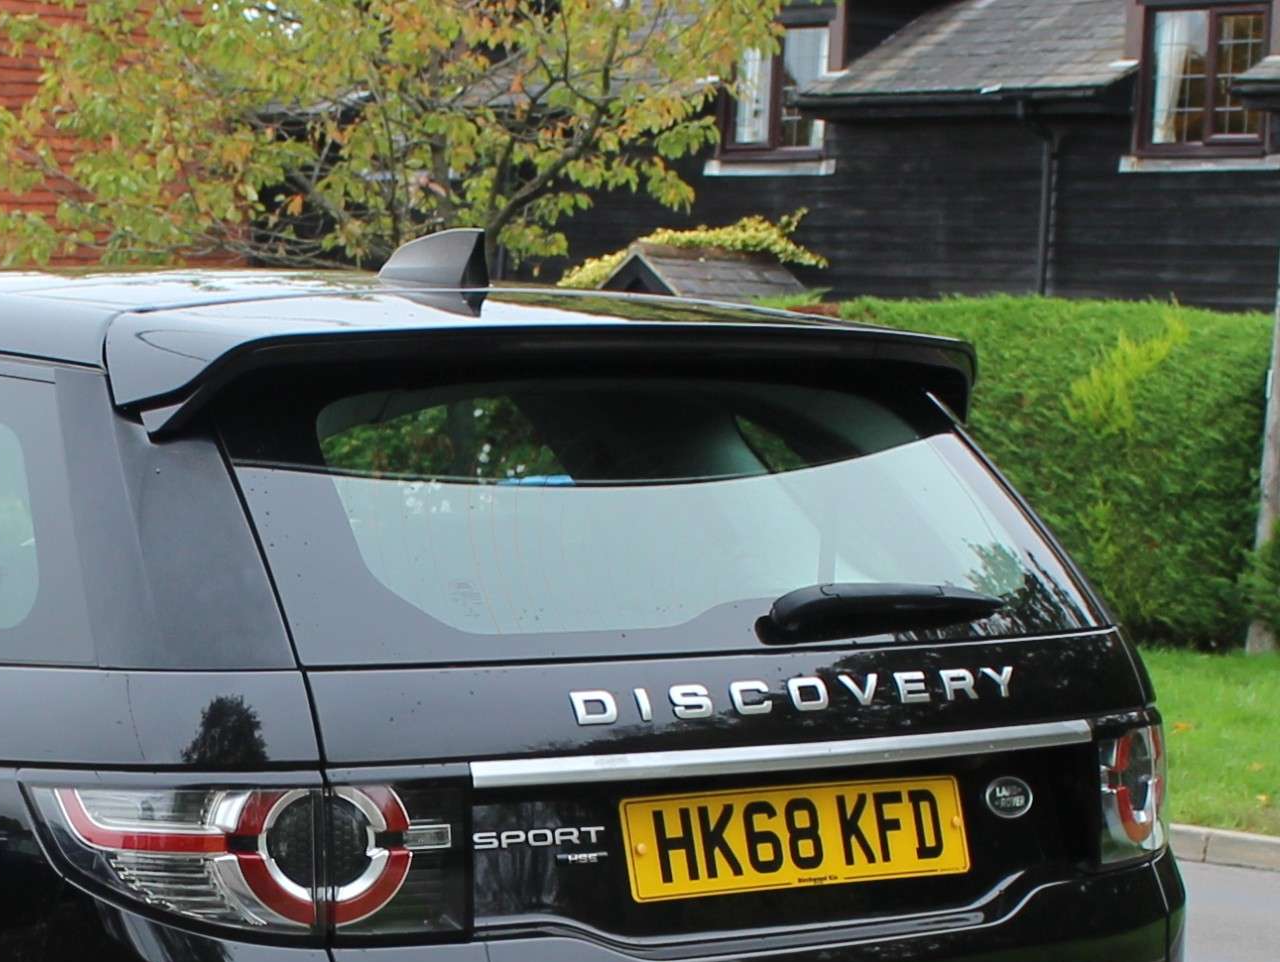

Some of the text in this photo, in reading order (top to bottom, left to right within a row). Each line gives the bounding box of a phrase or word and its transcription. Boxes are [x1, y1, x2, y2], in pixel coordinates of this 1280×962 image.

[569, 666, 1013, 725] DISCOVERY
[472, 826, 605, 850] SPORT
[652, 789, 944, 884] HK68 KFD
